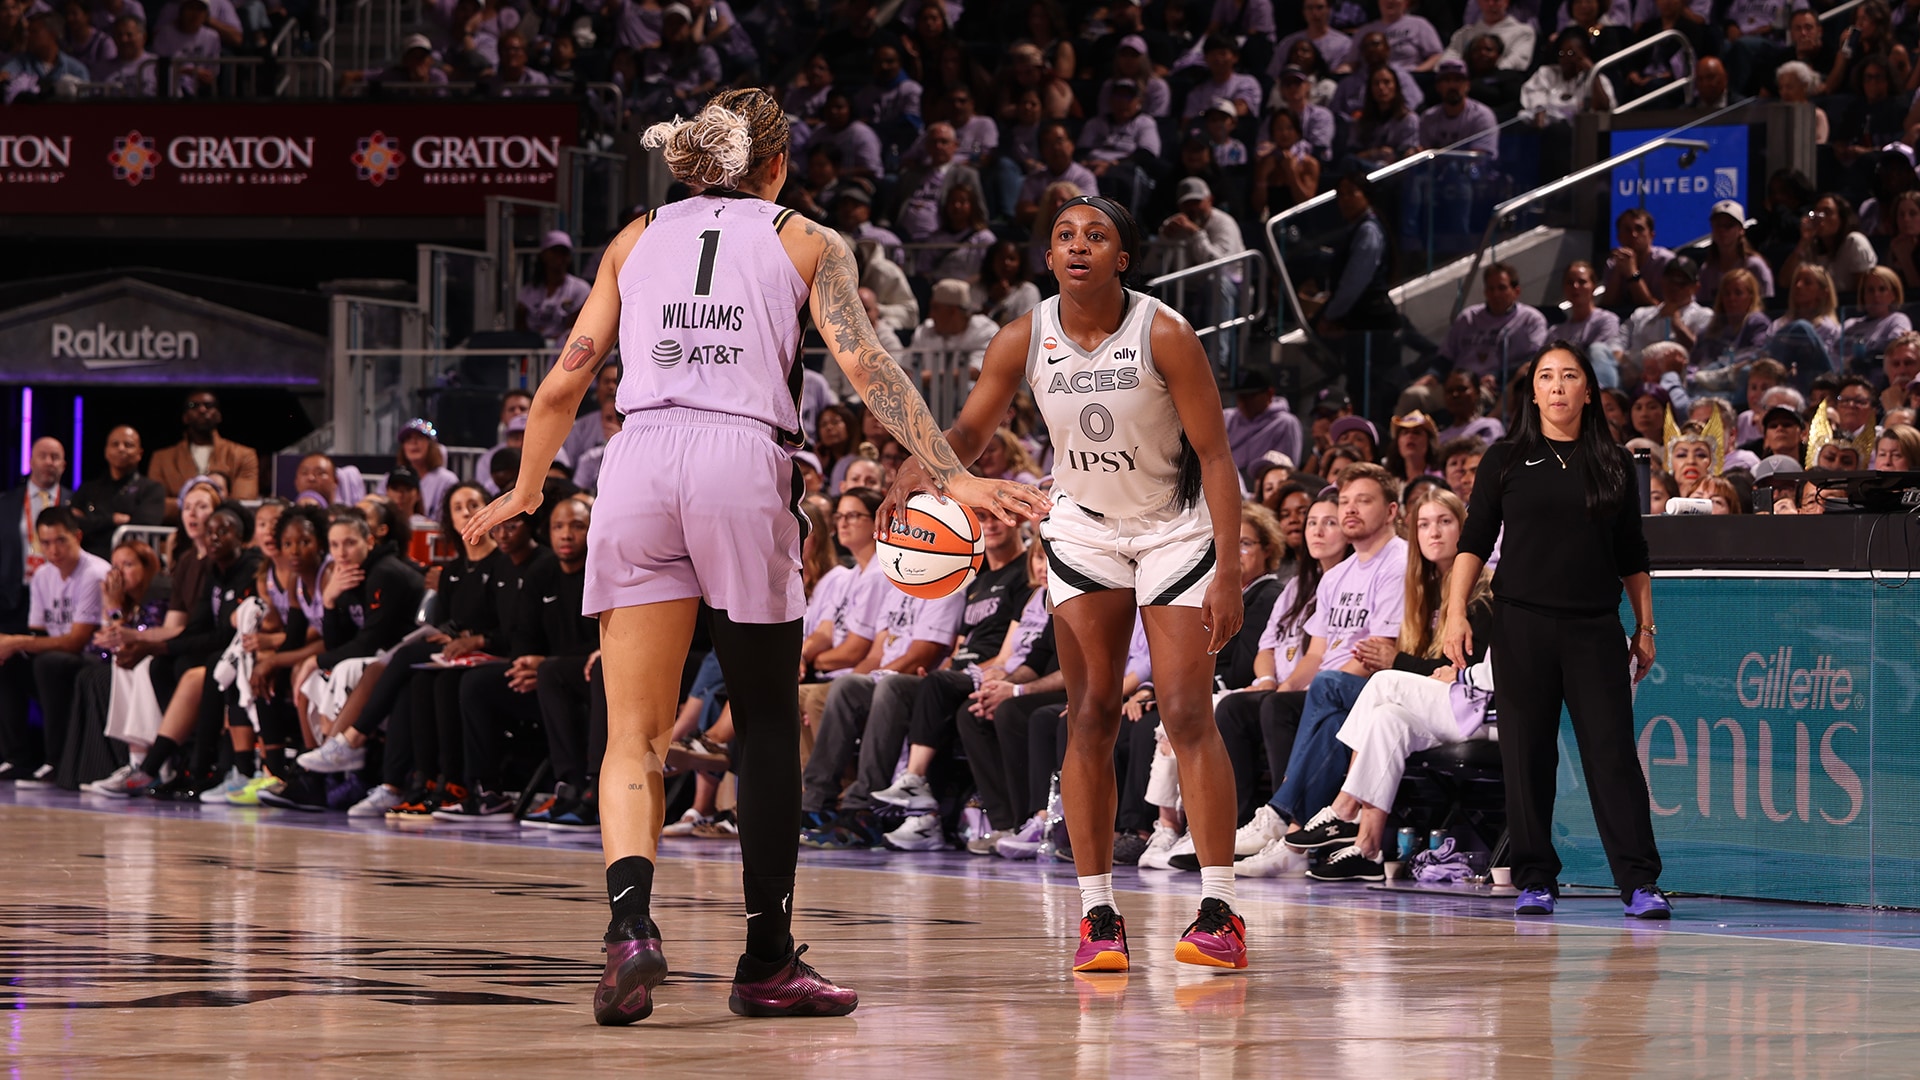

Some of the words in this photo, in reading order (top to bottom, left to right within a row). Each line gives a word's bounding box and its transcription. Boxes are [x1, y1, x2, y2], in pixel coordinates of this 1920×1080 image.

[168, 135, 314, 169] GRATON
[411, 136, 560, 169] GRATON
[1619, 176, 1708, 196] UNITED
[693, 228, 723, 297] 1
[662, 302, 745, 332] WILLIAMS
[52, 322, 199, 359] Rakuten
[687, 345, 744, 365] AT&T
[1113, 347, 1137, 361] ally
[1047, 366, 1140, 394] ACES
[1079, 402, 1115, 442] 0
[1068, 445, 1140, 474] IPSY
[1636, 714, 1864, 826] enus
